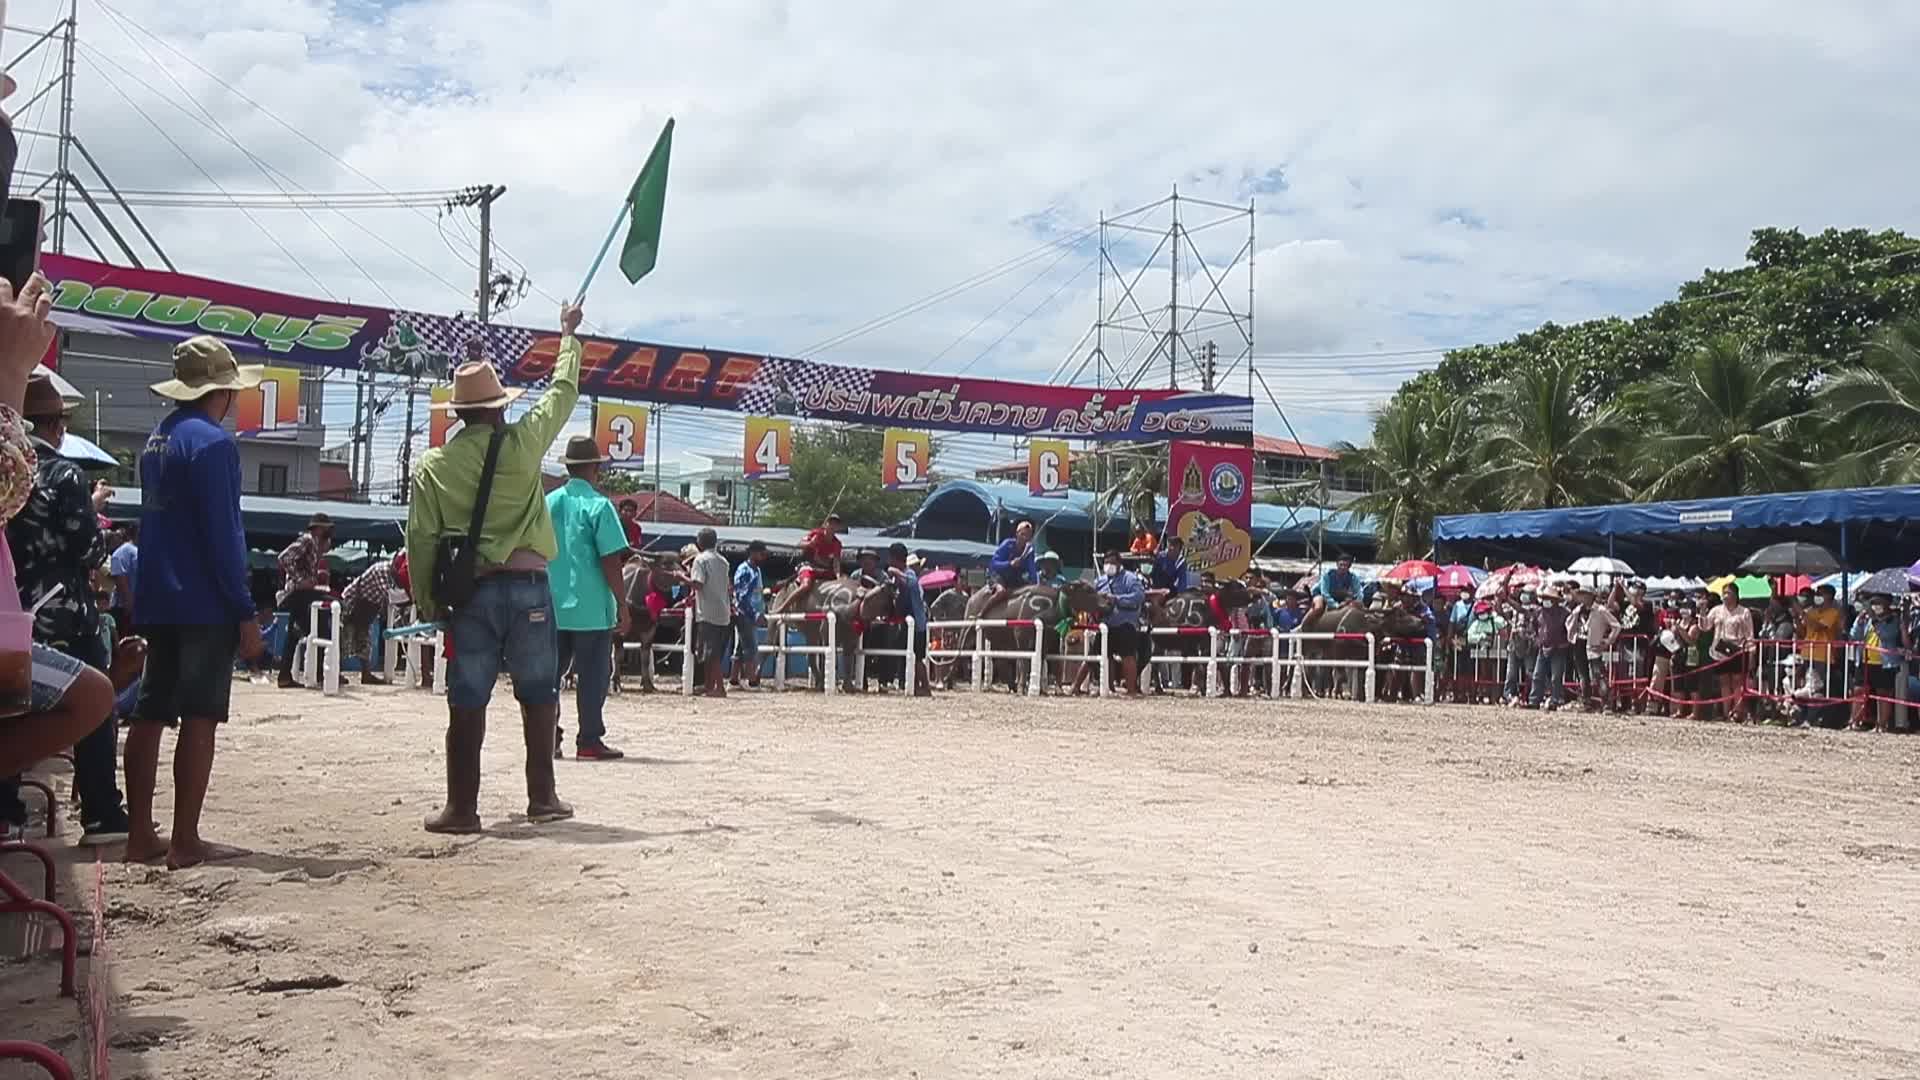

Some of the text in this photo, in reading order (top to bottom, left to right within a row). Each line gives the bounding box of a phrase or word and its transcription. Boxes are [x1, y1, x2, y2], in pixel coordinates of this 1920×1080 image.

[258, 379, 280, 431] 1
[803, 383, 1048, 429] ประเพณีวิ่งควาย
[1052, 392, 1141, 433] ครั้งที่
[608, 414, 635, 461] 3
[754, 430, 780, 473] 4
[895, 440, 918, 483] 5
[1039, 451, 1059, 491] 6
